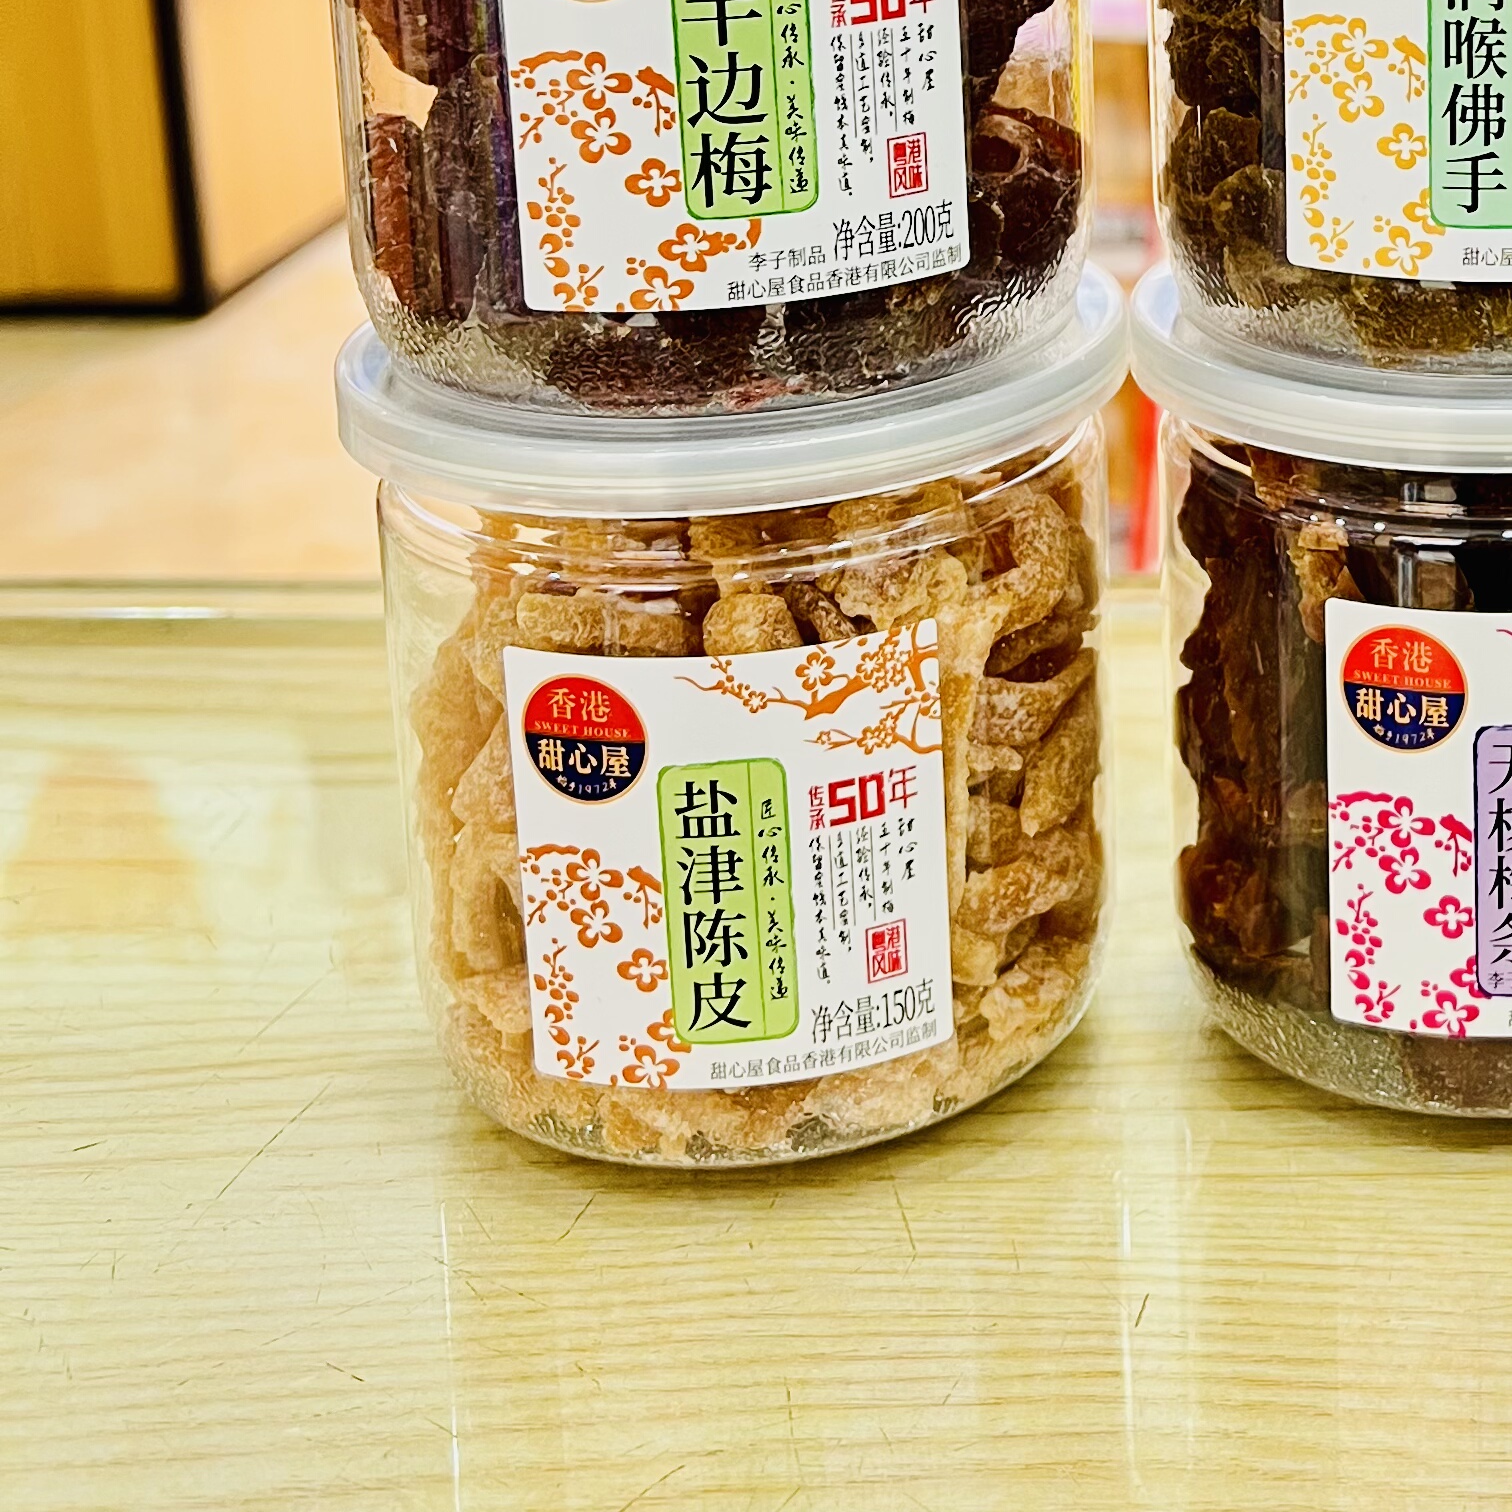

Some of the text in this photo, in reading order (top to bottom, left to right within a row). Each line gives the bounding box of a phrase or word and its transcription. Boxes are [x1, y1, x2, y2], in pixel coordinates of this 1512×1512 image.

[726, 242, 963, 303] 甜心屋食品香港有限公司监制
[748, 243, 826, 272] 李子制品
[1369, 637, 1434, 675] 香港
[1352, 667, 1453, 690] SWEET HOUSE
[546, 686, 613, 725] 香港
[1355, 687, 1451, 729] 甜心屋
[533, 718, 632, 740] SWEET HOUSE
[538, 737, 633, 780] 甜心屋
[674, 778, 753, 1034] 盐津陈皮
[710, 1017, 938, 1081] 甜心屋食品香港有限公司监制
